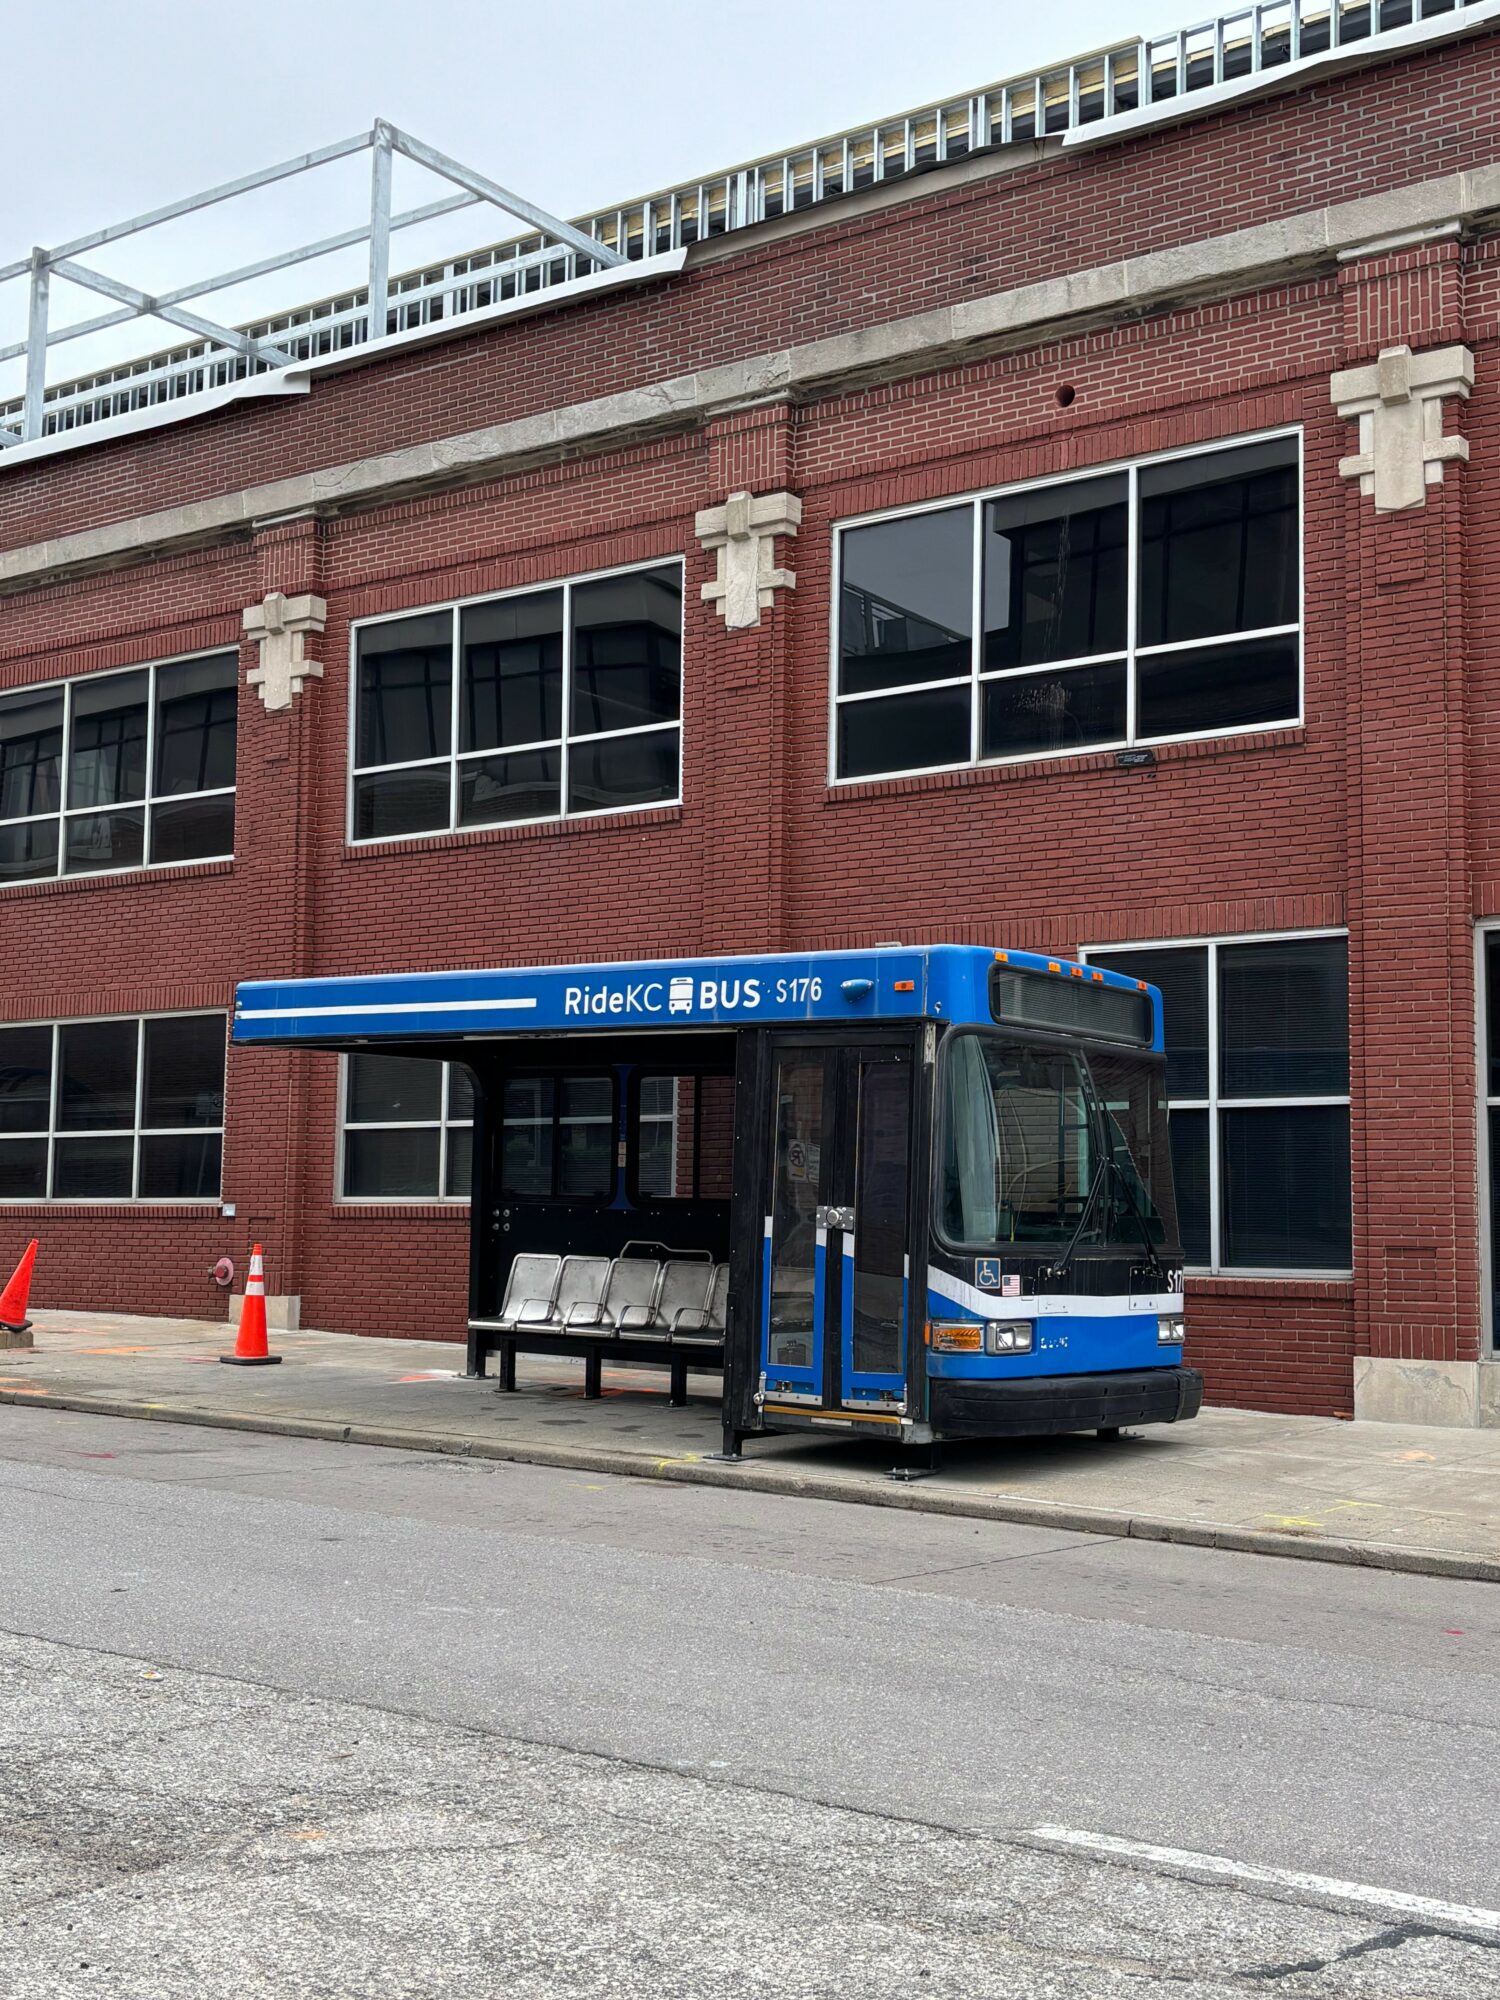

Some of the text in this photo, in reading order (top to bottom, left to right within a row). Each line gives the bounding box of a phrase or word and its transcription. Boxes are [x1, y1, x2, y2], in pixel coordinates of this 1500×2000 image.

[564, 977, 822, 1015] RideKC BUS S176
[1167, 1269, 1184, 1293] S17
